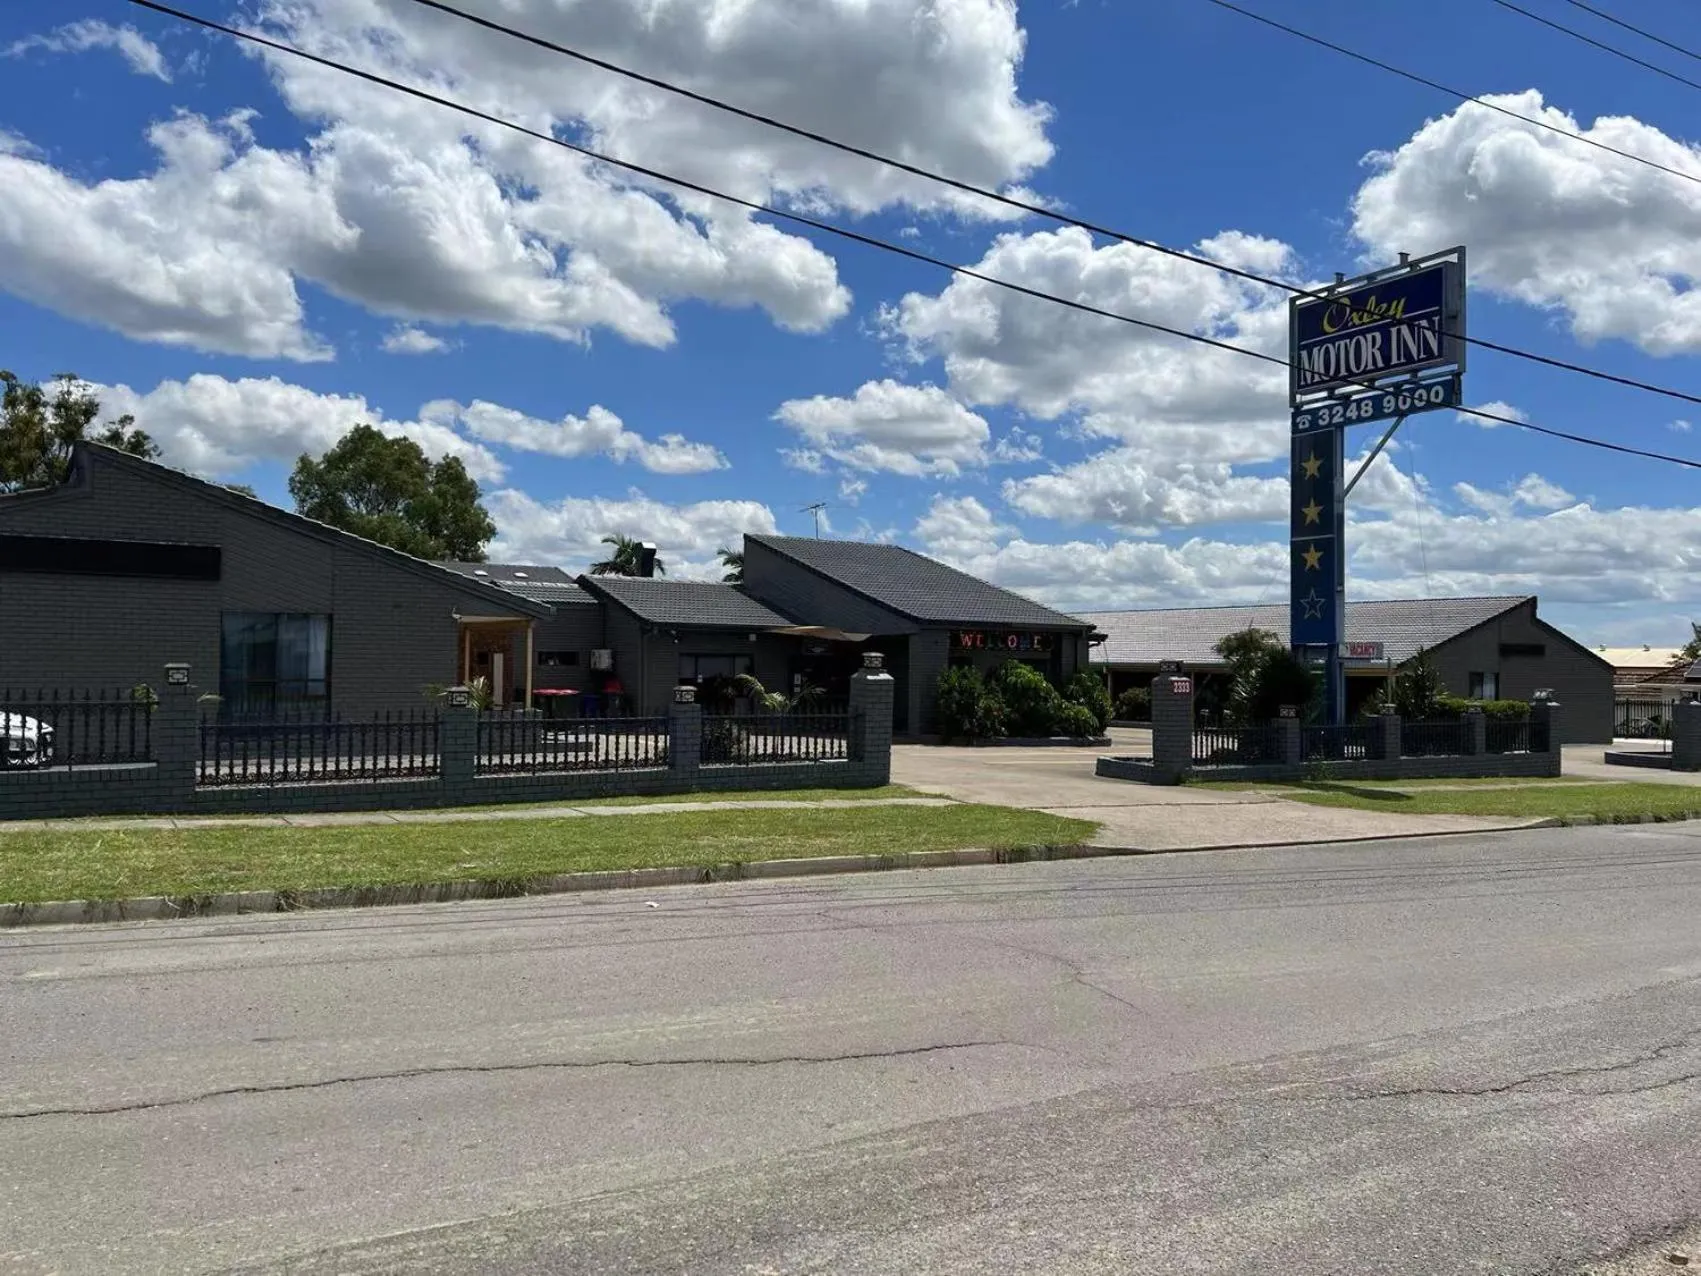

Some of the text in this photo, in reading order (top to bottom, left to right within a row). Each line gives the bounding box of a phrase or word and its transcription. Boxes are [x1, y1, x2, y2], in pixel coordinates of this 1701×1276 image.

[1322, 295, 1407, 334] Oxley
[1300, 316, 1440, 386] MOTOR INN
[1318, 385, 1445, 426] 3248 9000
